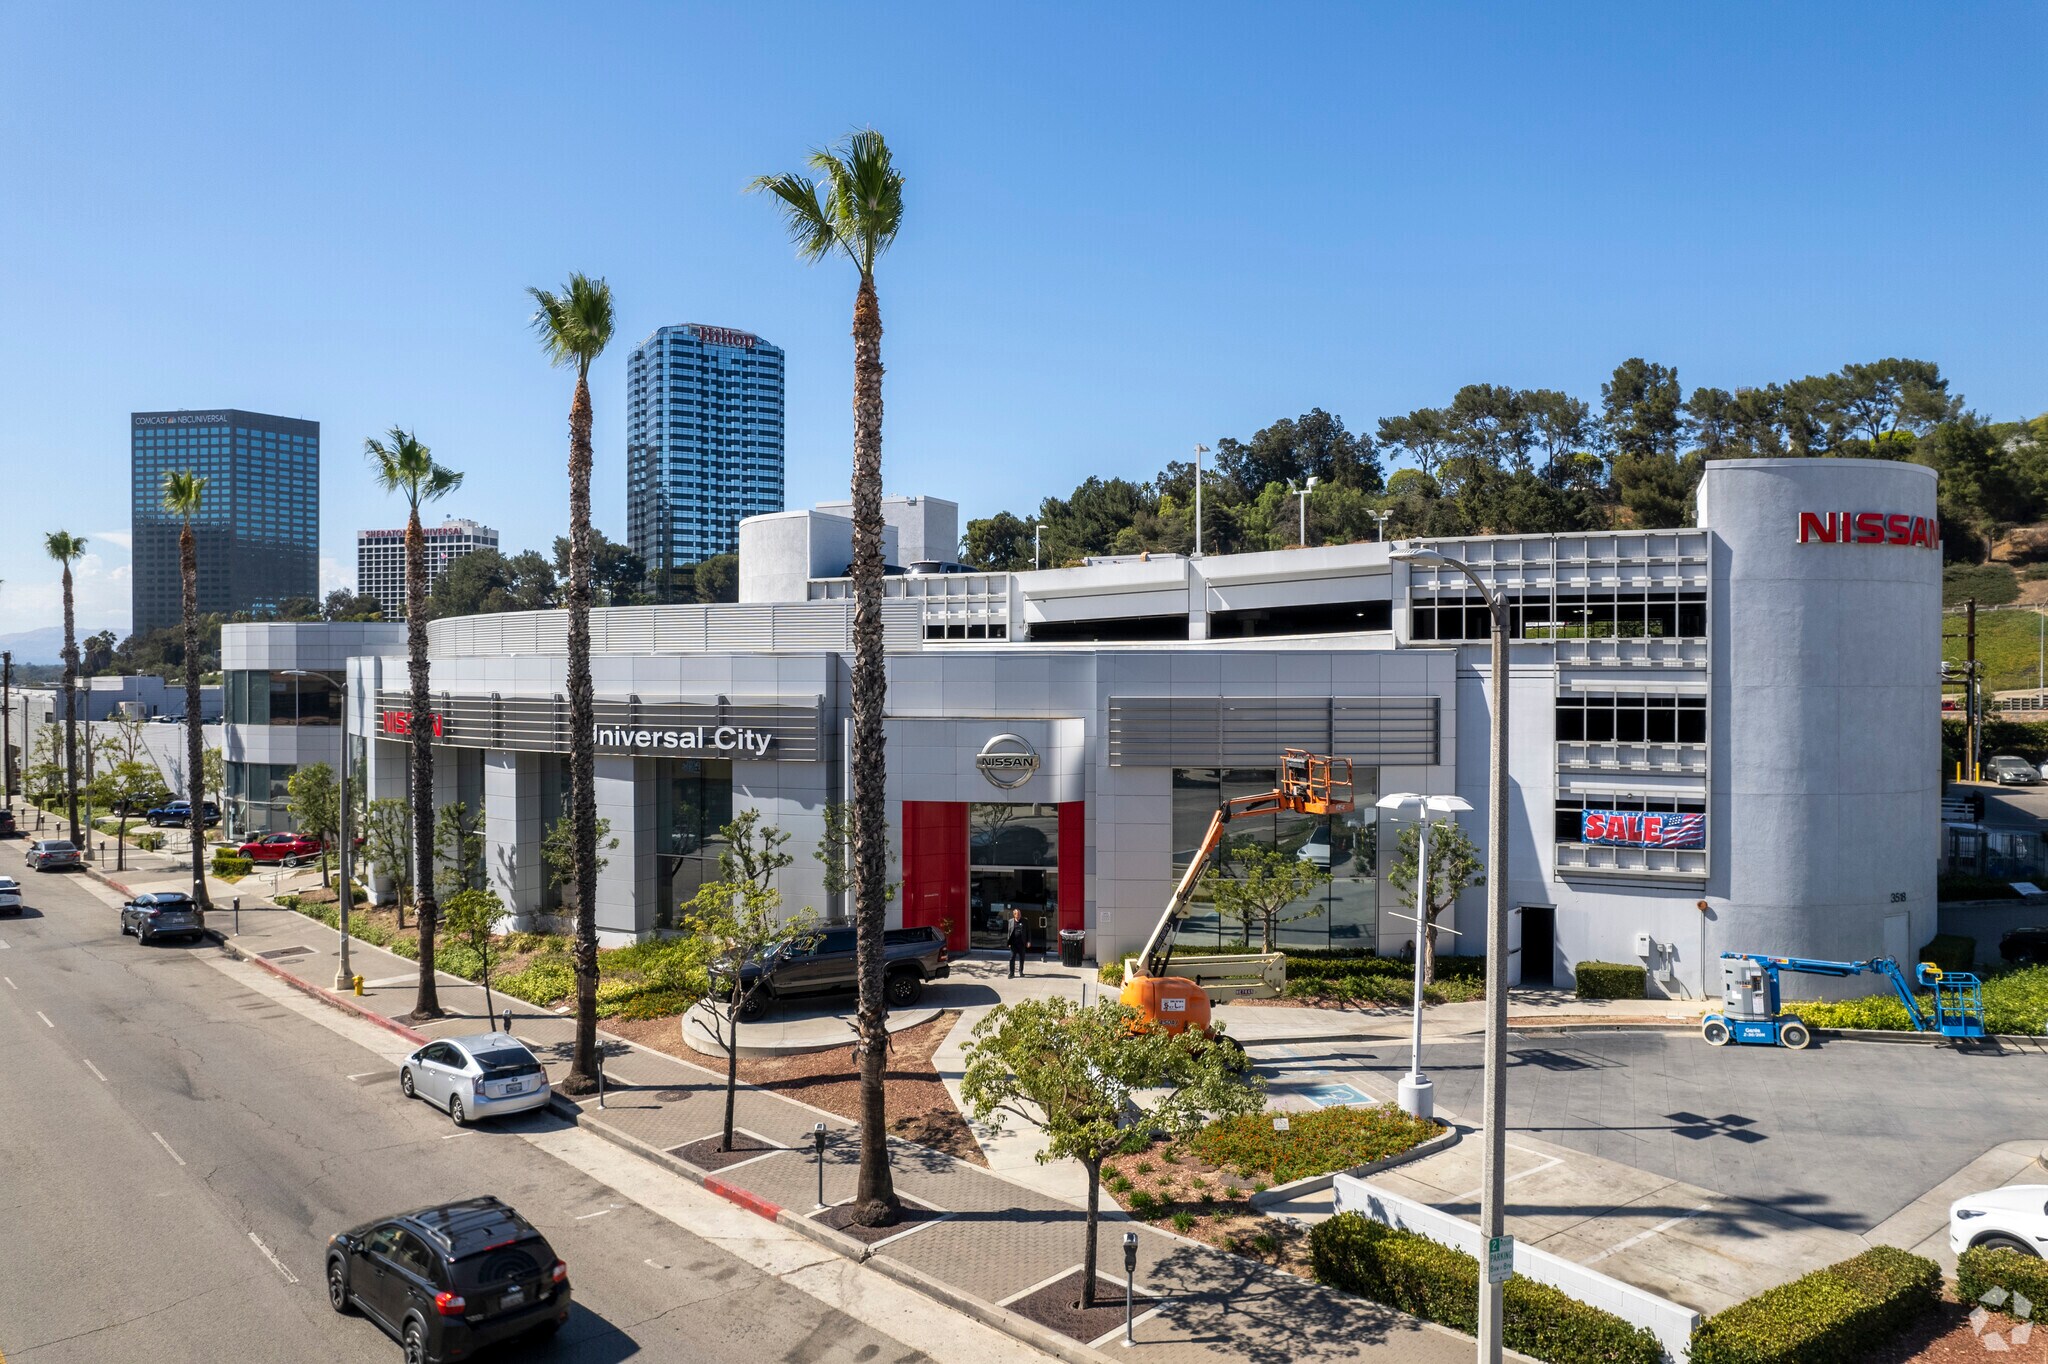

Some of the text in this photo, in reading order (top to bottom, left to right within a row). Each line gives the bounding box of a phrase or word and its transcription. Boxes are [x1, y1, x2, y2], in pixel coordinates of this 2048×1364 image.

[699, 326, 755, 348] Hilton
[135, 414, 228, 425] COMCAST NBCUNIVERSAL
[423, 527, 464, 536] NIVERSAL
[1797, 511, 1940, 550] NISSAN
[714, 726, 772, 756] City
[982, 757, 1033, 767] NISSAN
[1585, 814, 1664, 844] SALE
[1490, 1250, 1513, 1263] PARKING
